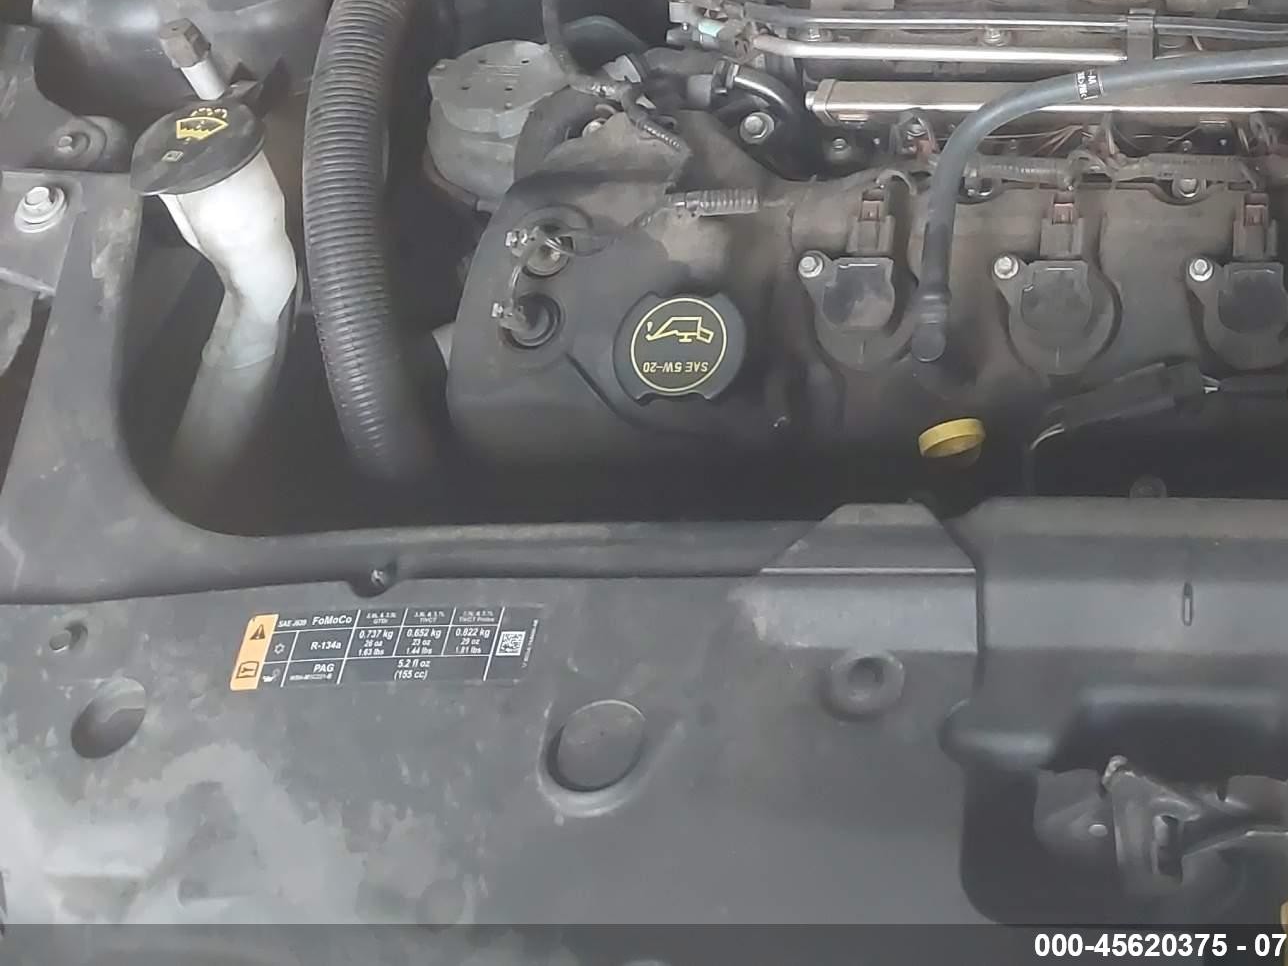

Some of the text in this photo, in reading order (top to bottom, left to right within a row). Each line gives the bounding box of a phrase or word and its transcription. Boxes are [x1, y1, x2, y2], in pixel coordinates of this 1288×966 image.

[643, 361, 709, 373] SAE 5W-20
[311, 615, 352, 626] FoMoCo
[359, 629, 394, 640] 0.737 kg
[407, 627, 442, 639] 0.652 kg
[455, 627, 491, 639] 0.822 kg
[310, 641, 342, 651] R-134a
[313, 663, 335, 673] PAG
[397, 658, 411, 668] 5.2
[419, 660, 431, 668] oz
[394, 669, 413, 681] (155
